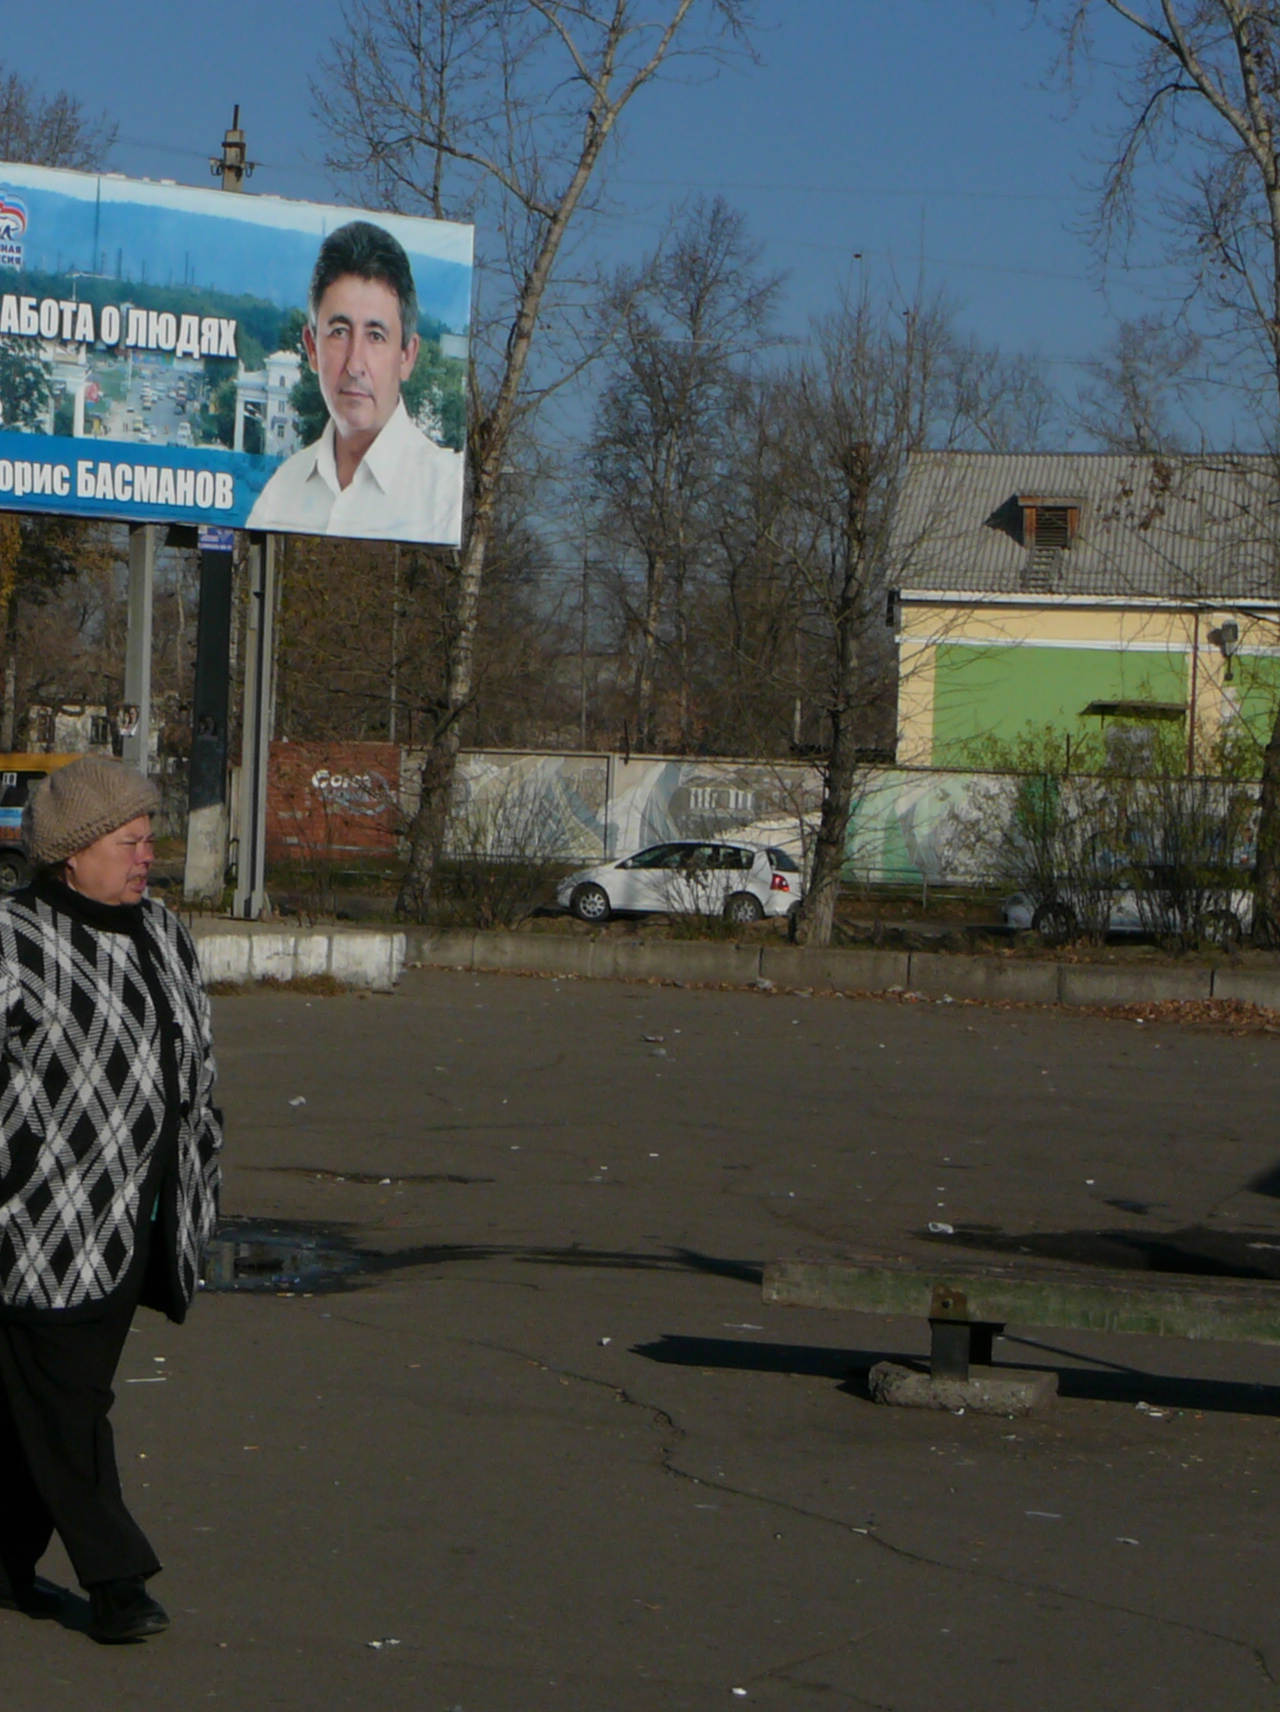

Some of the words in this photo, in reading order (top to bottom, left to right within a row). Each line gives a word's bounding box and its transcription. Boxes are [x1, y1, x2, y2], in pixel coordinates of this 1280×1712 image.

[100, 304, 120, 346] О
[125, 308, 238, 358] ЛЮДЯХ
[77, 460, 235, 510] БАСМАНОВ
